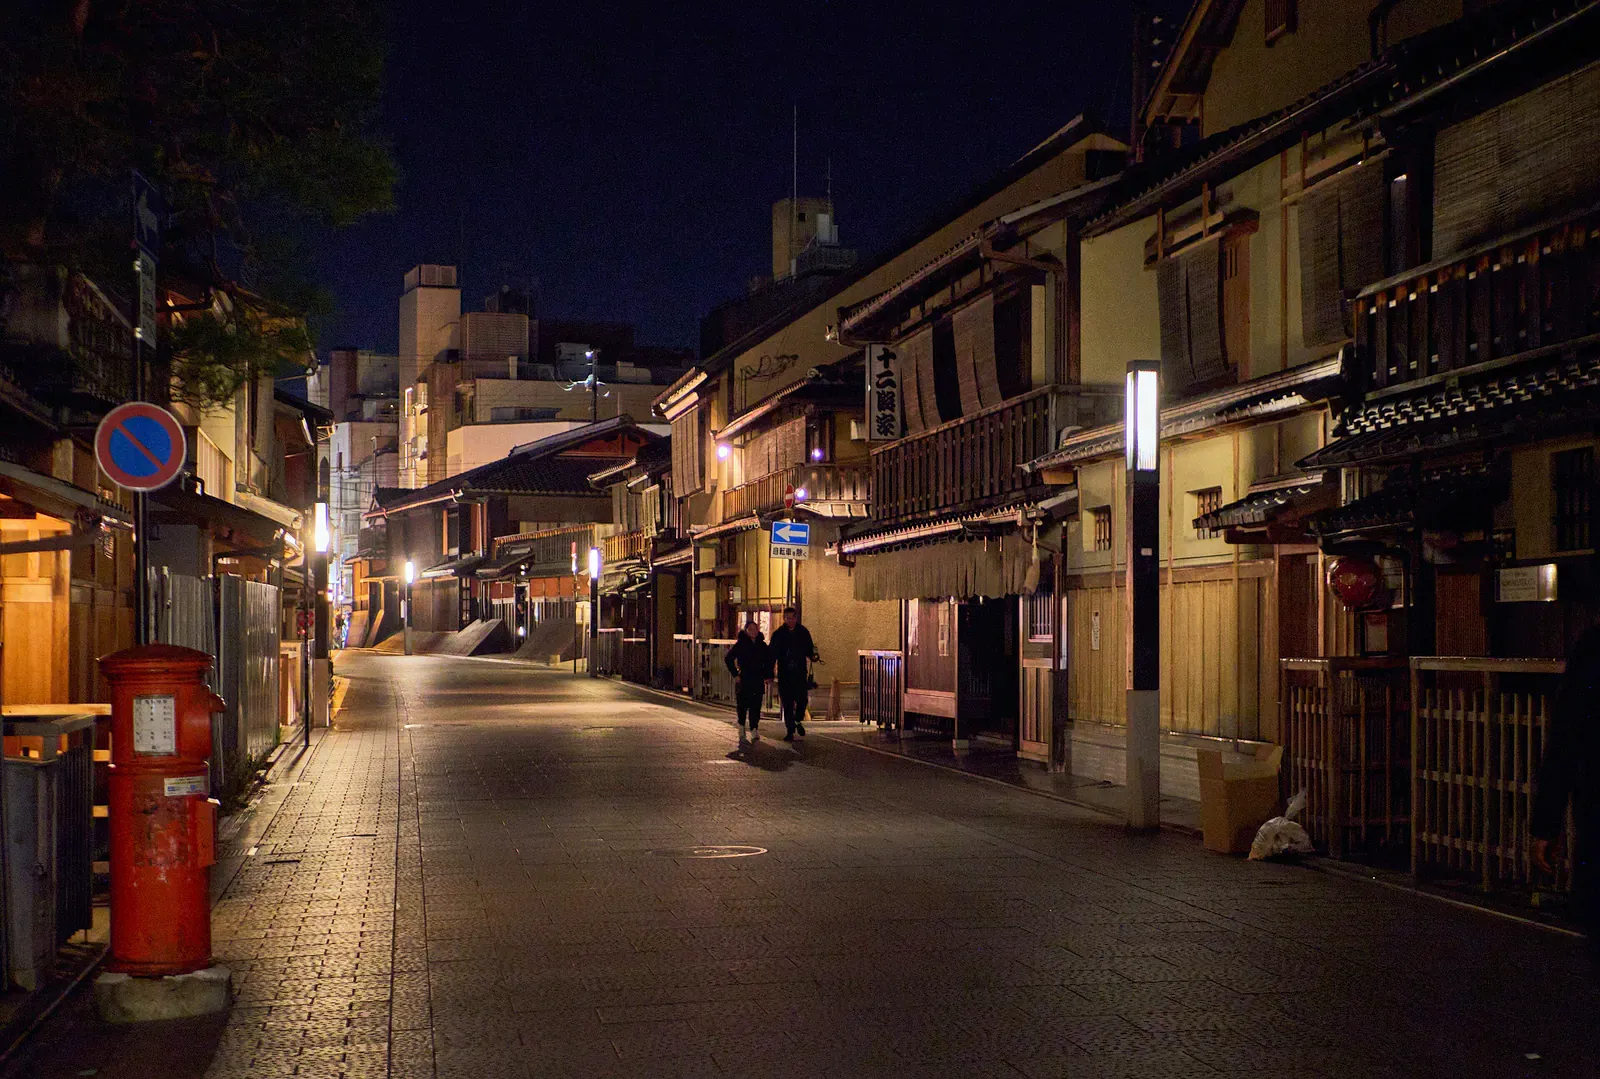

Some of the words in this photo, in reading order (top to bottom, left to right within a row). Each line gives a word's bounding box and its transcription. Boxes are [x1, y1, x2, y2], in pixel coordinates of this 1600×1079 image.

[773, 546, 807, 558] 自転車を除く
